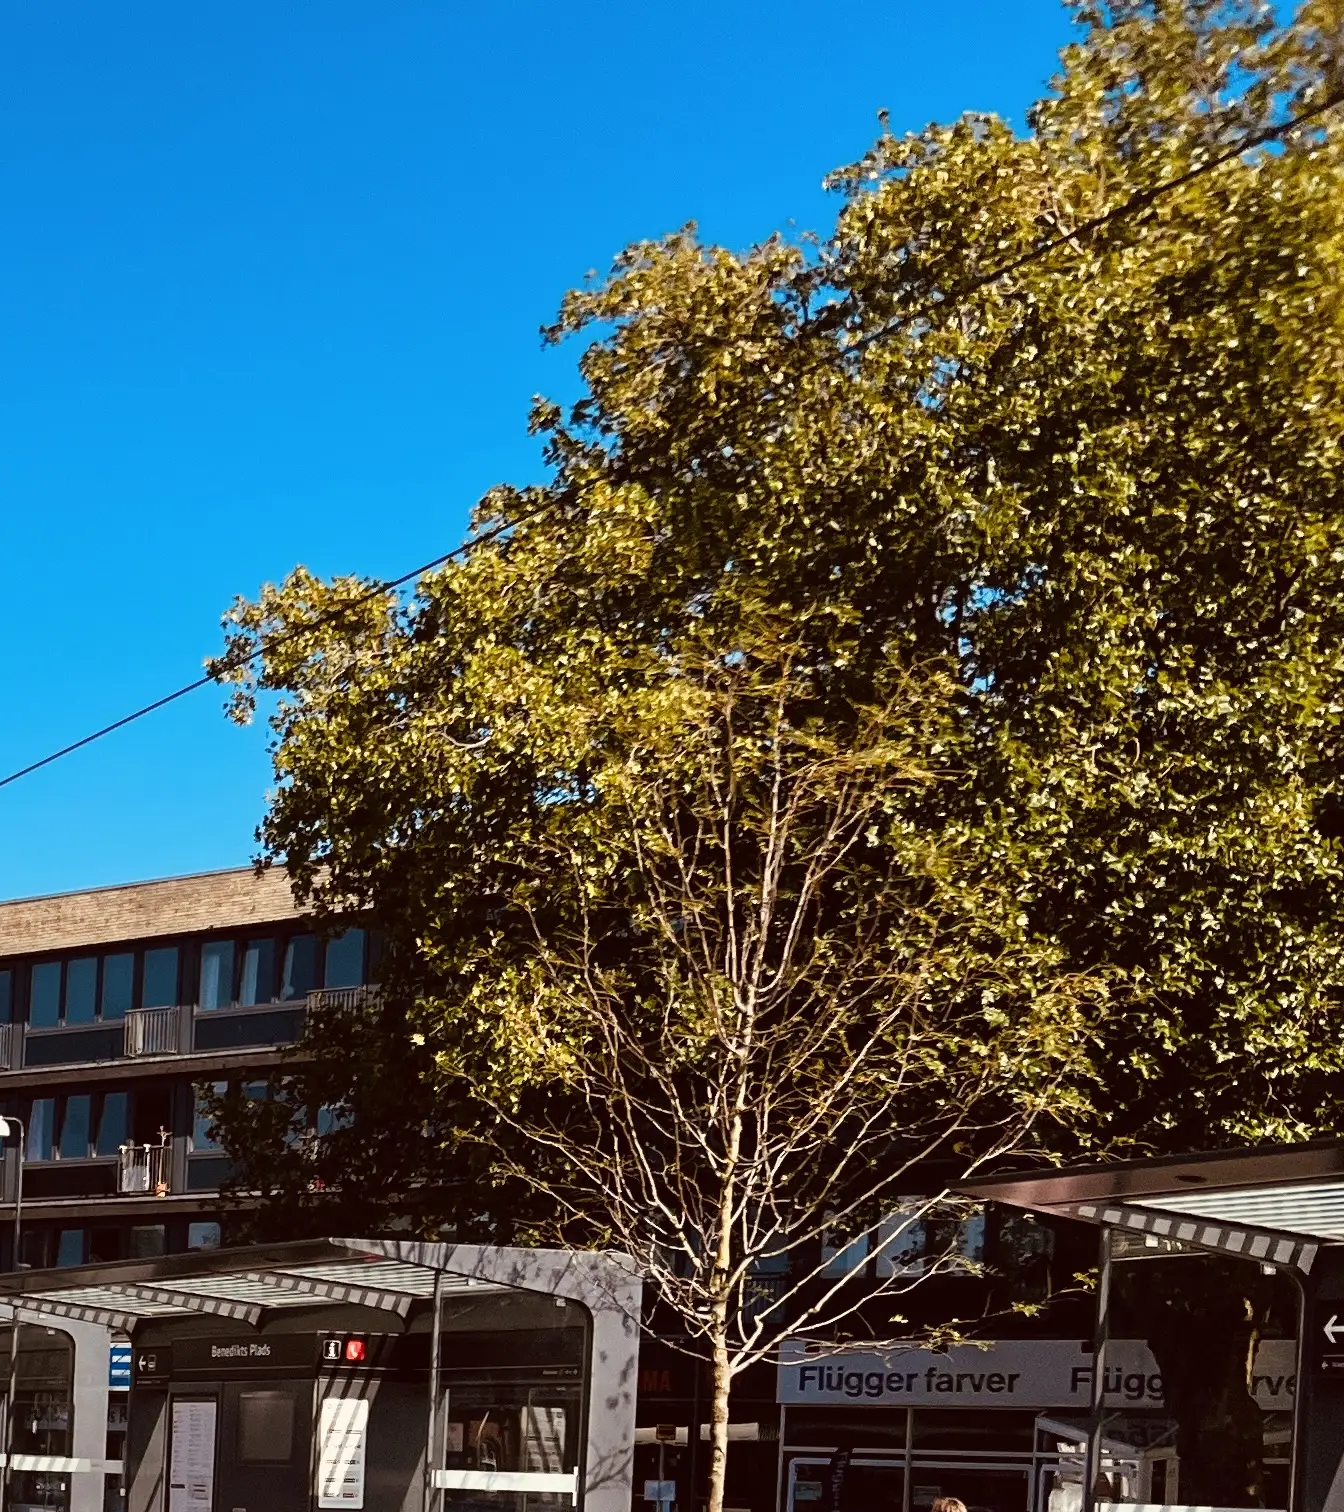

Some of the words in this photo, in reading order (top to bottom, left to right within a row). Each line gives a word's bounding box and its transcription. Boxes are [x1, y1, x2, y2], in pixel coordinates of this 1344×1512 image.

[249, 1343, 271, 1356] Plads
[798, 1365, 918, 1398] Flügger
[924, 1366, 1020, 1393] farver
